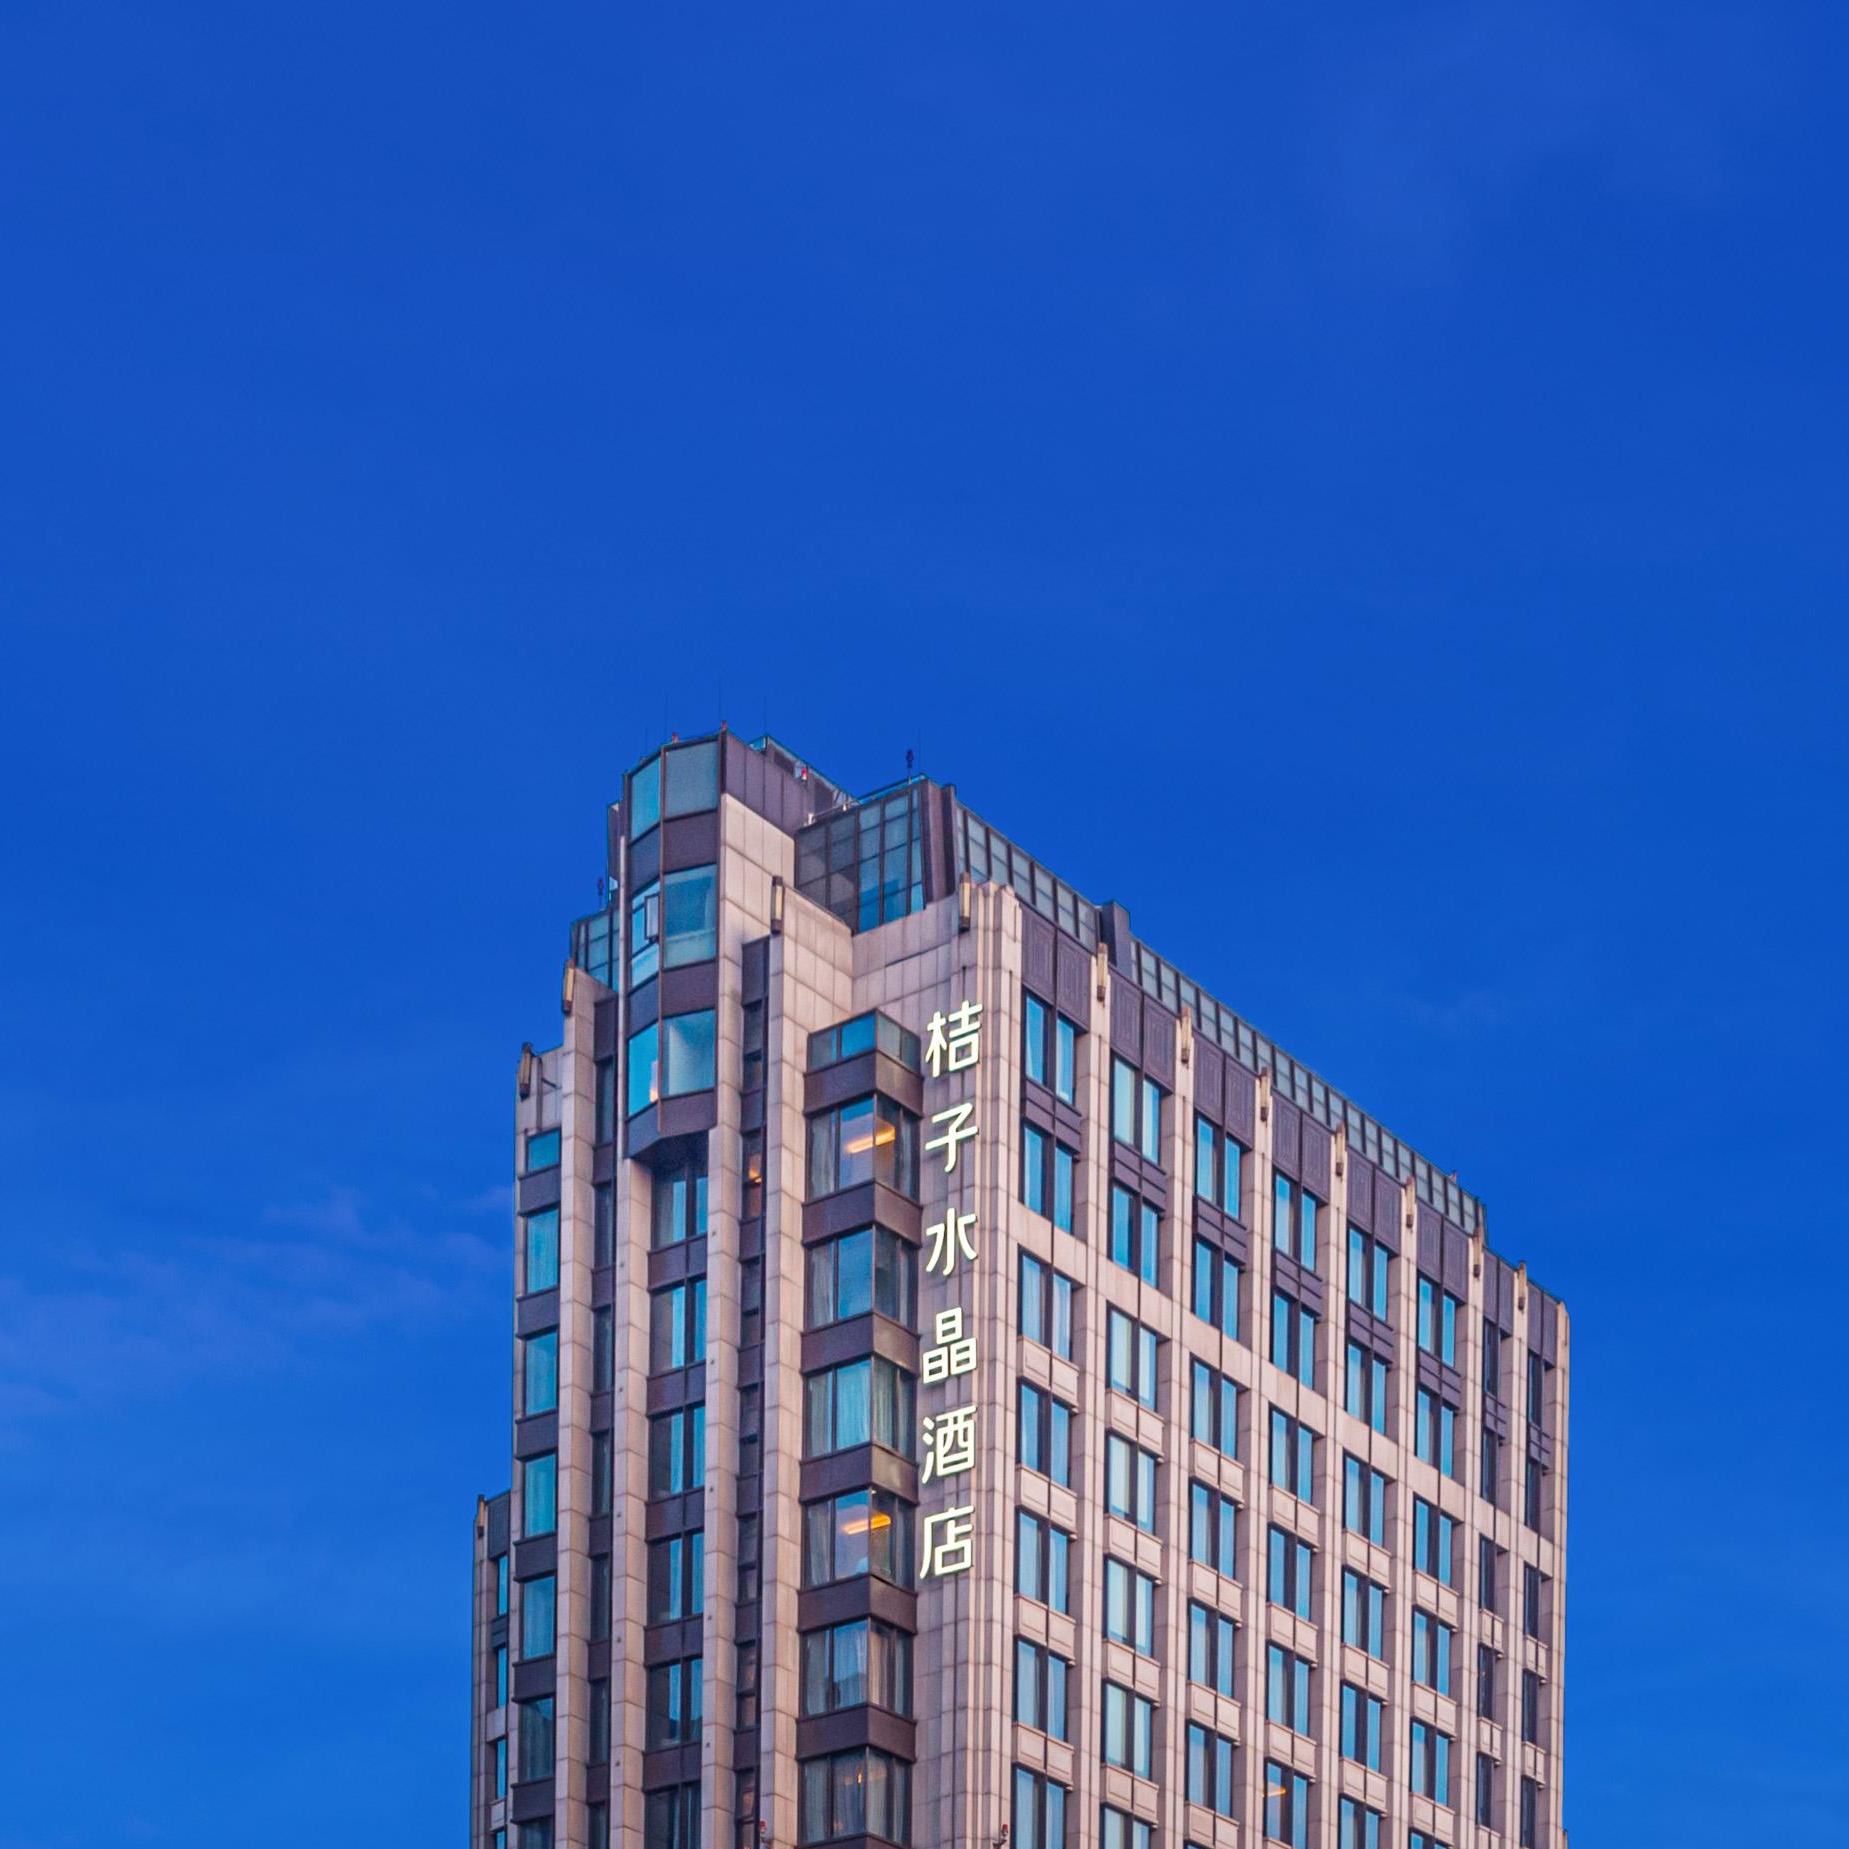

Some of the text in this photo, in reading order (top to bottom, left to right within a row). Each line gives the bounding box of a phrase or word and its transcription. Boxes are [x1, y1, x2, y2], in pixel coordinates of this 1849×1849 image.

[919, 999, 983, 1580] 桔子水晶酒店
